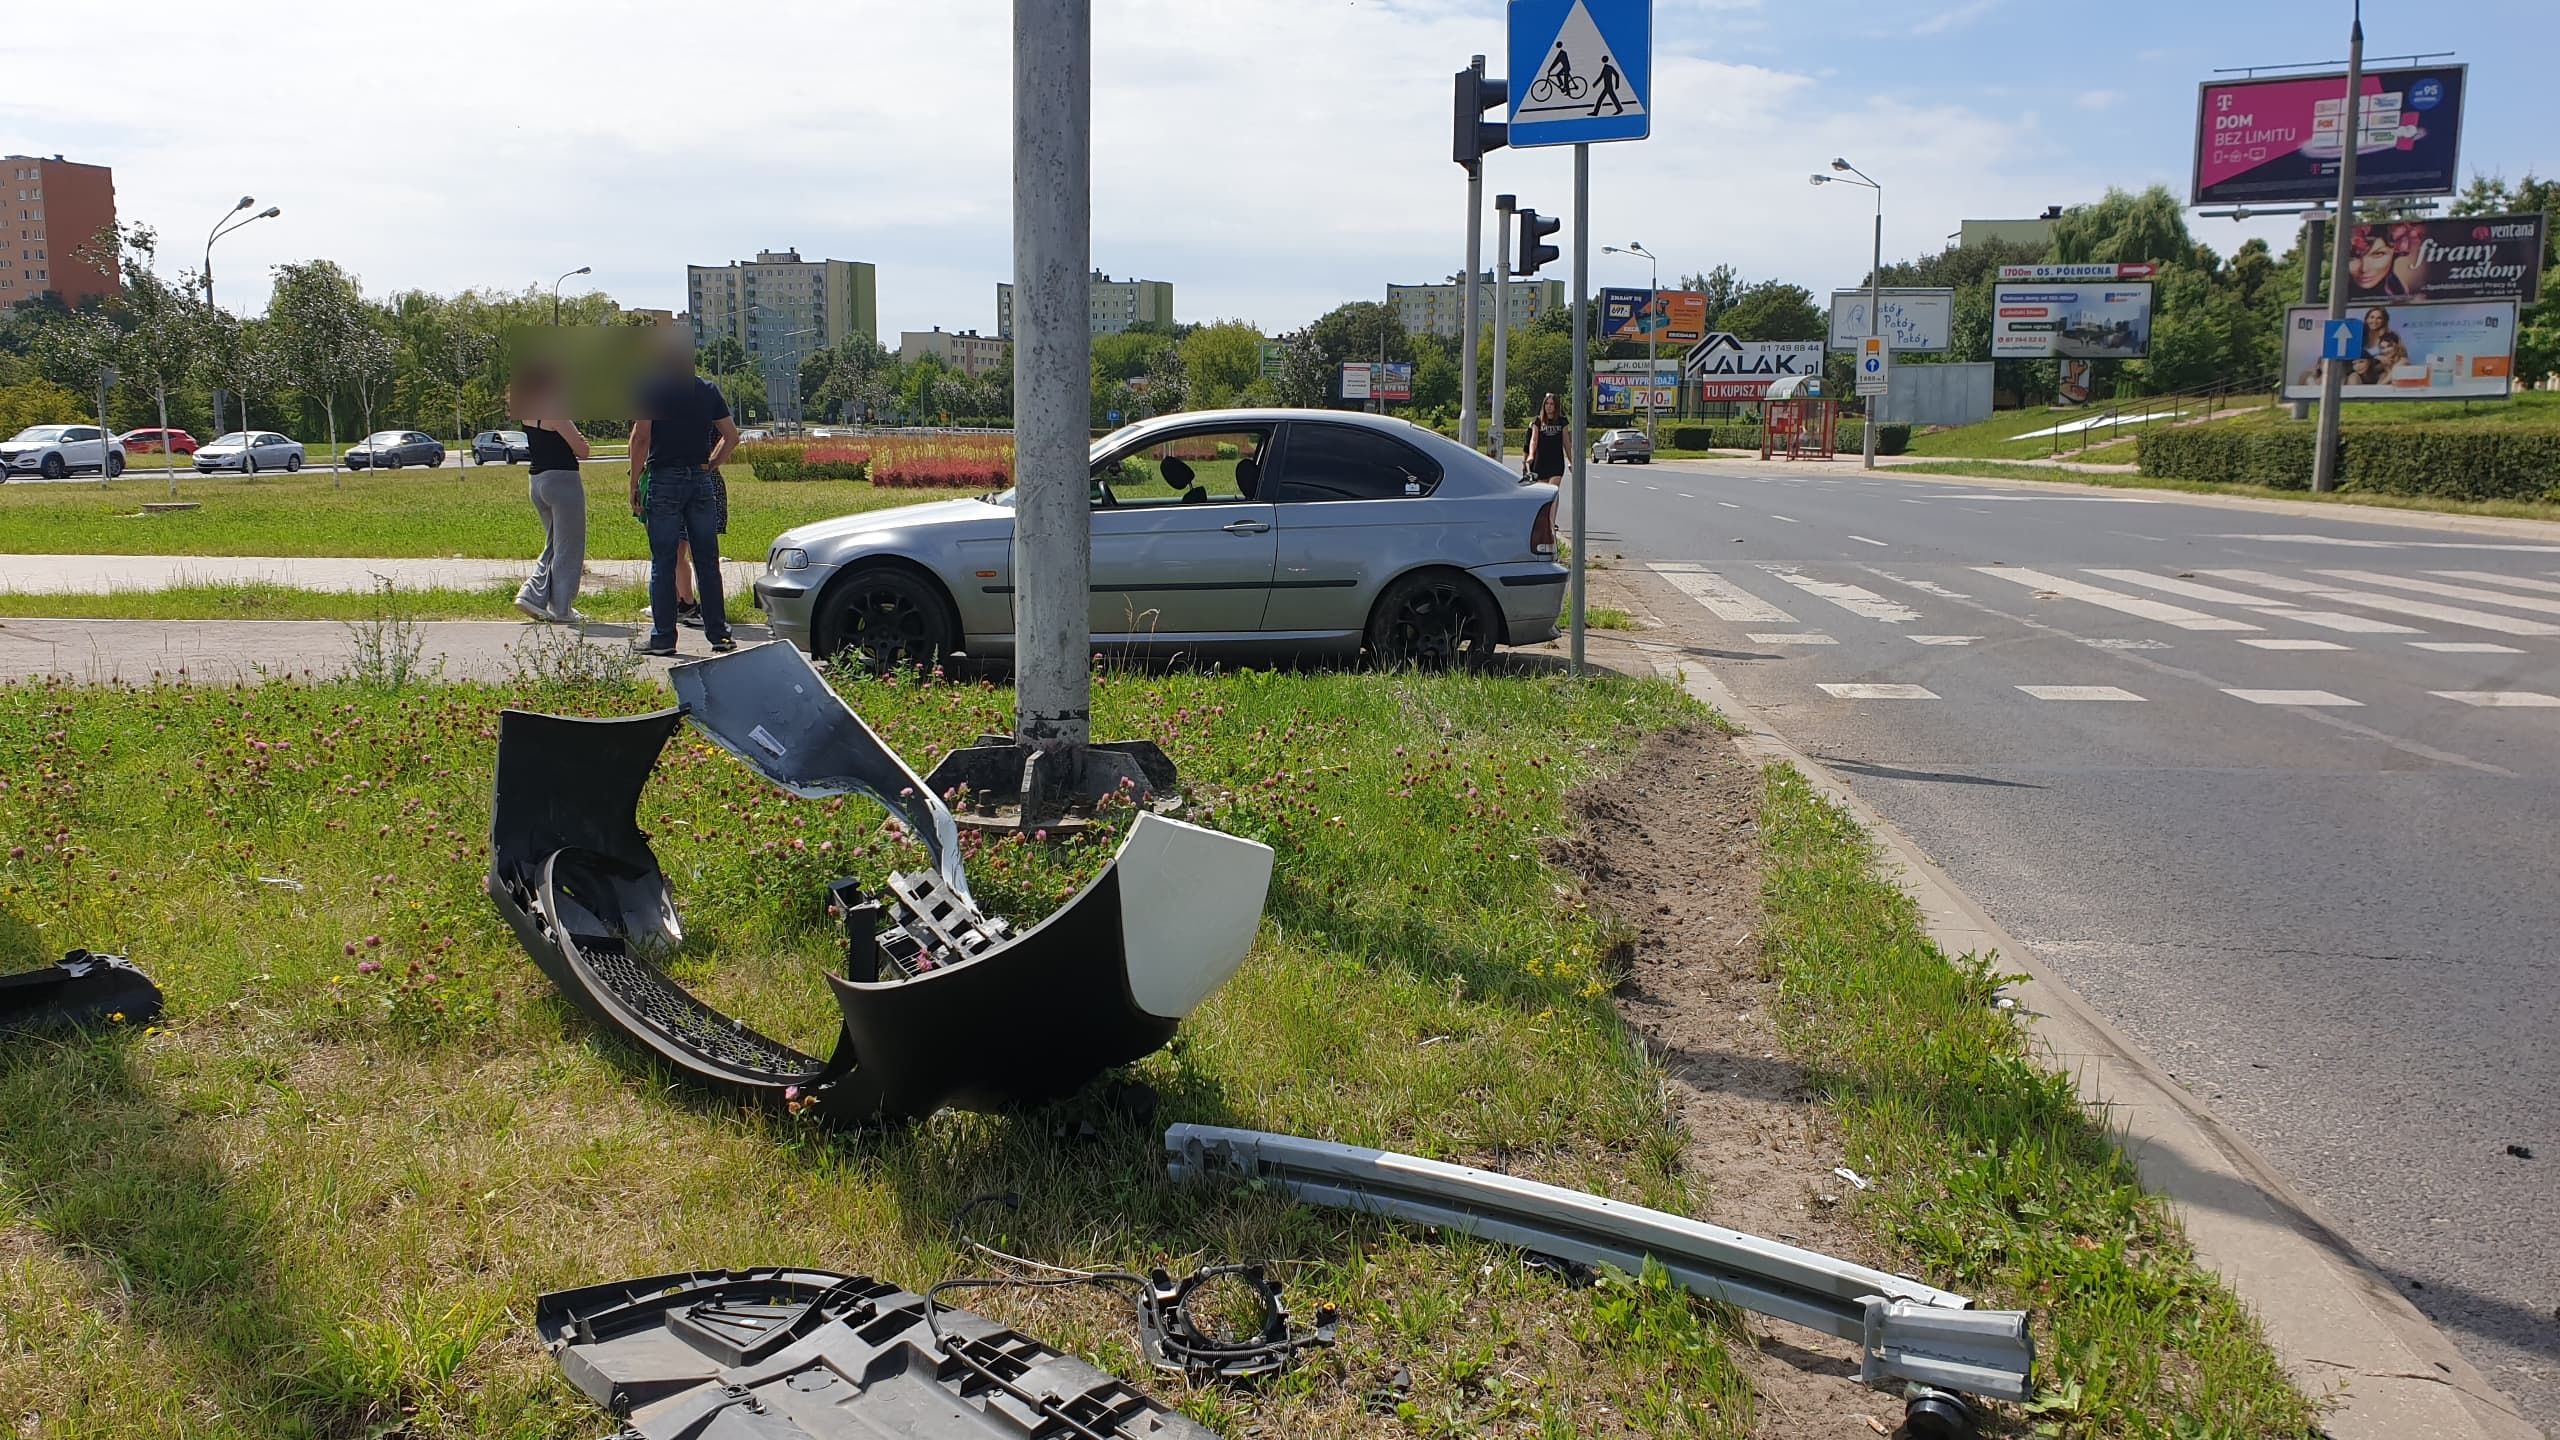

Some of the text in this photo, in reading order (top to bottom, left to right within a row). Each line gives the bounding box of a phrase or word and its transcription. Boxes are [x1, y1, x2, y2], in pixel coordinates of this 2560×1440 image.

[2216, 114, 2253, 130] DOM
[2215, 128, 2296, 146] BEZ LIMITU
[2491, 224, 2535, 238] ventana
[2410, 238, 2498, 270] firany
[2004, 266, 2111, 277] 1700m OS. PÓŁNOCNA
[1760, 344, 1819, 352] 81 749 88 44
[1598, 376, 1675, 386] WIELKA WYPREDAŻ!
[1706, 385, 1718, 397] TU
[1720, 385, 1754, 397] KUPISZ
